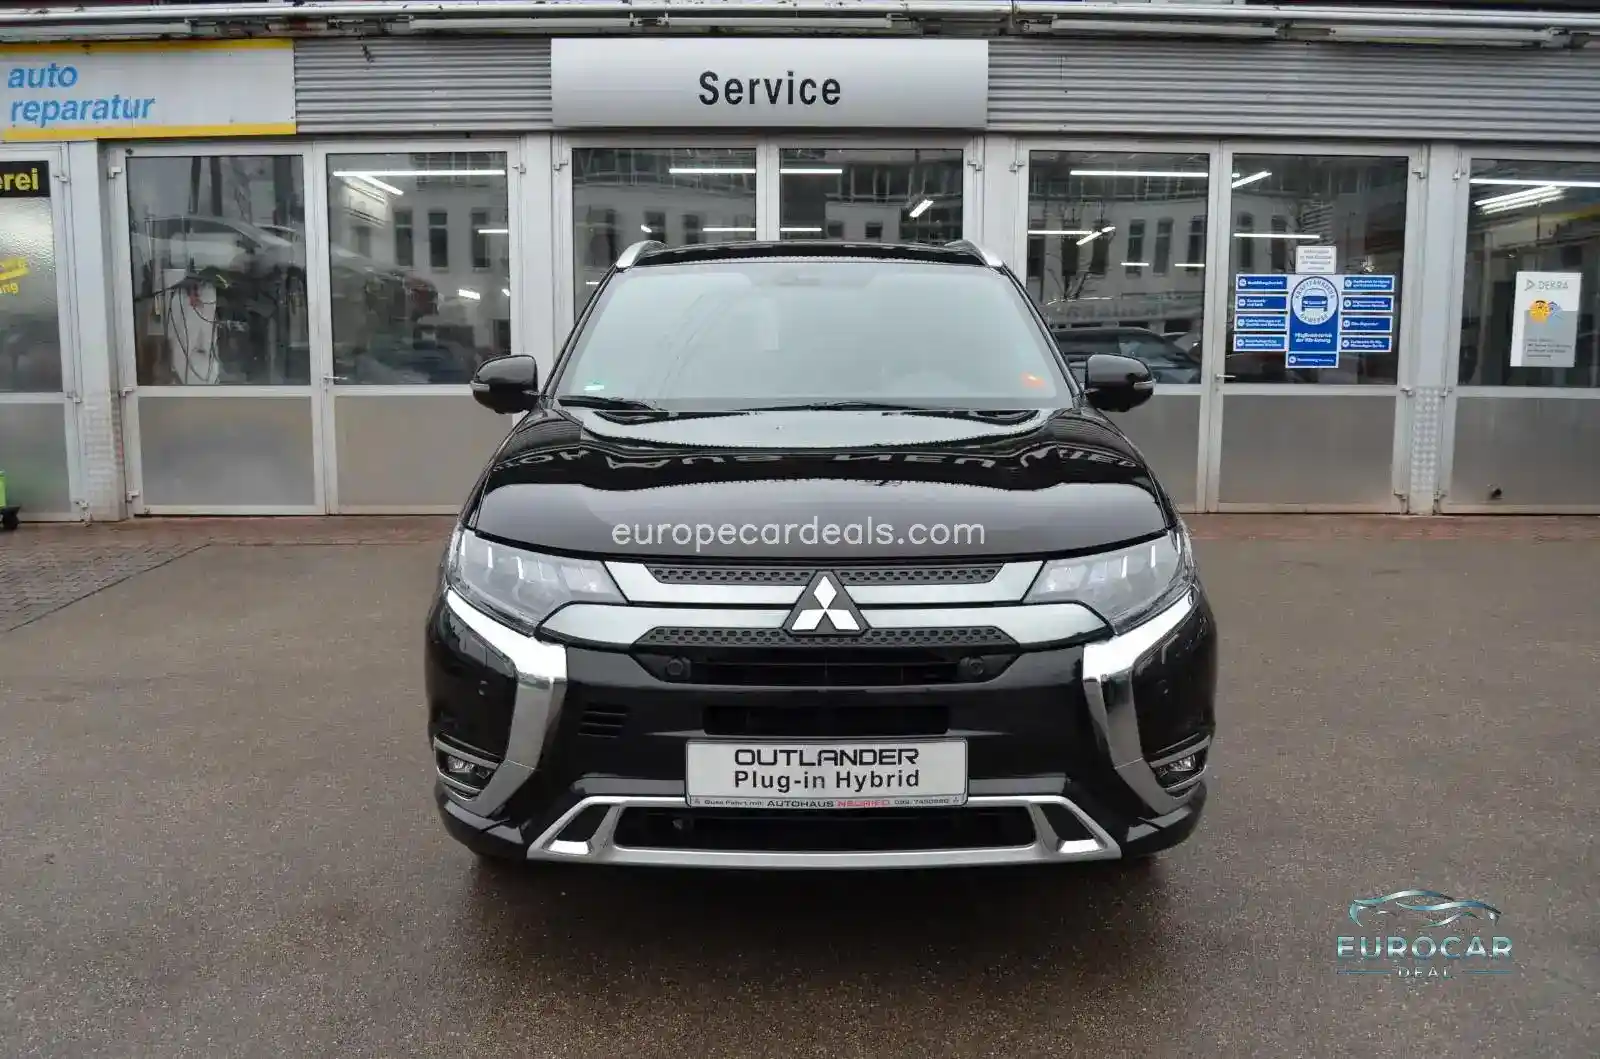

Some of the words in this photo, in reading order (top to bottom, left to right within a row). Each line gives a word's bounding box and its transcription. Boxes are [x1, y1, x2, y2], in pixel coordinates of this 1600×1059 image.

[8, 63, 77, 88] auto
[699, 70, 841, 105] Service
[10, 95, 155, 127] reparatur
[0, 167, 39, 191] rei
[734, 748, 919, 766] OUTLANDER
[734, 770, 825, 793] Plug-in
[836, 769, 920, 793] Hybrid
[767, 799, 834, 807] AUTOHAUS
